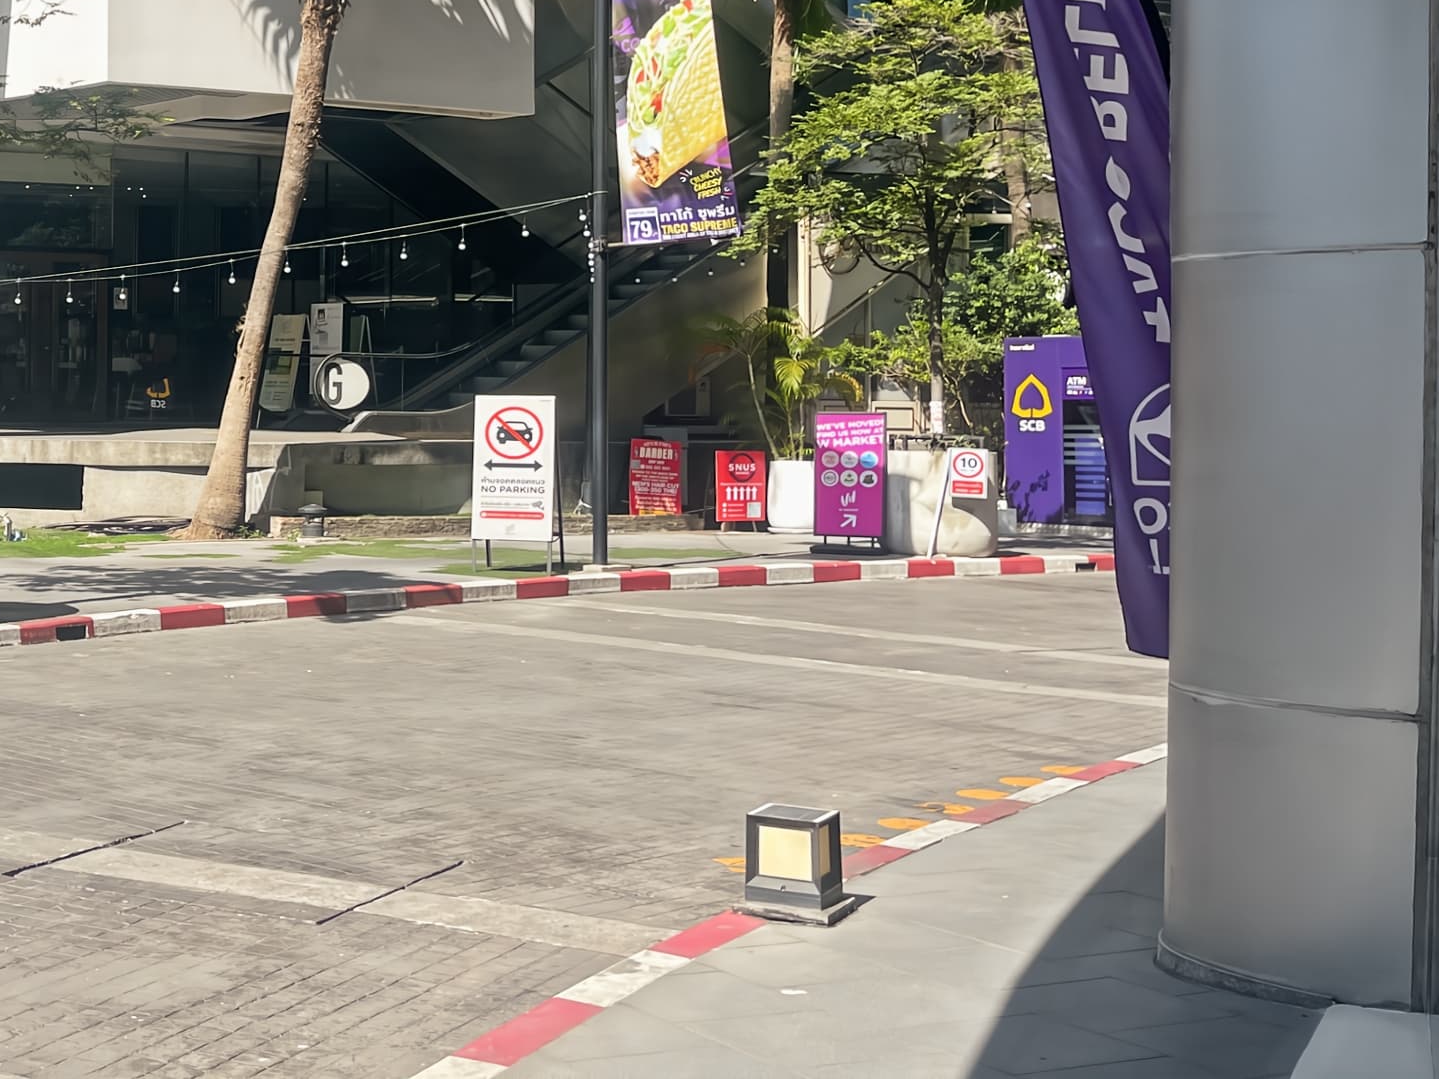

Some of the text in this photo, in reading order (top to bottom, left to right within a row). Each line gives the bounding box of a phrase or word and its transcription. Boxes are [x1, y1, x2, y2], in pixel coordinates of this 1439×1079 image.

[693, 176, 722, 192] CHEESY
[661, 222, 689, 235] TACO
[690, 217, 738, 233] SUPREME
[1066, 376, 1087, 386] ATM
[1019, 419, 1046, 432] SCB
[817, 434, 884, 448] W MARKET
[728, 463, 756, 471] SNUS
[961, 457, 978, 469] 10
[481, 485, 545, 494] NO PARKING
